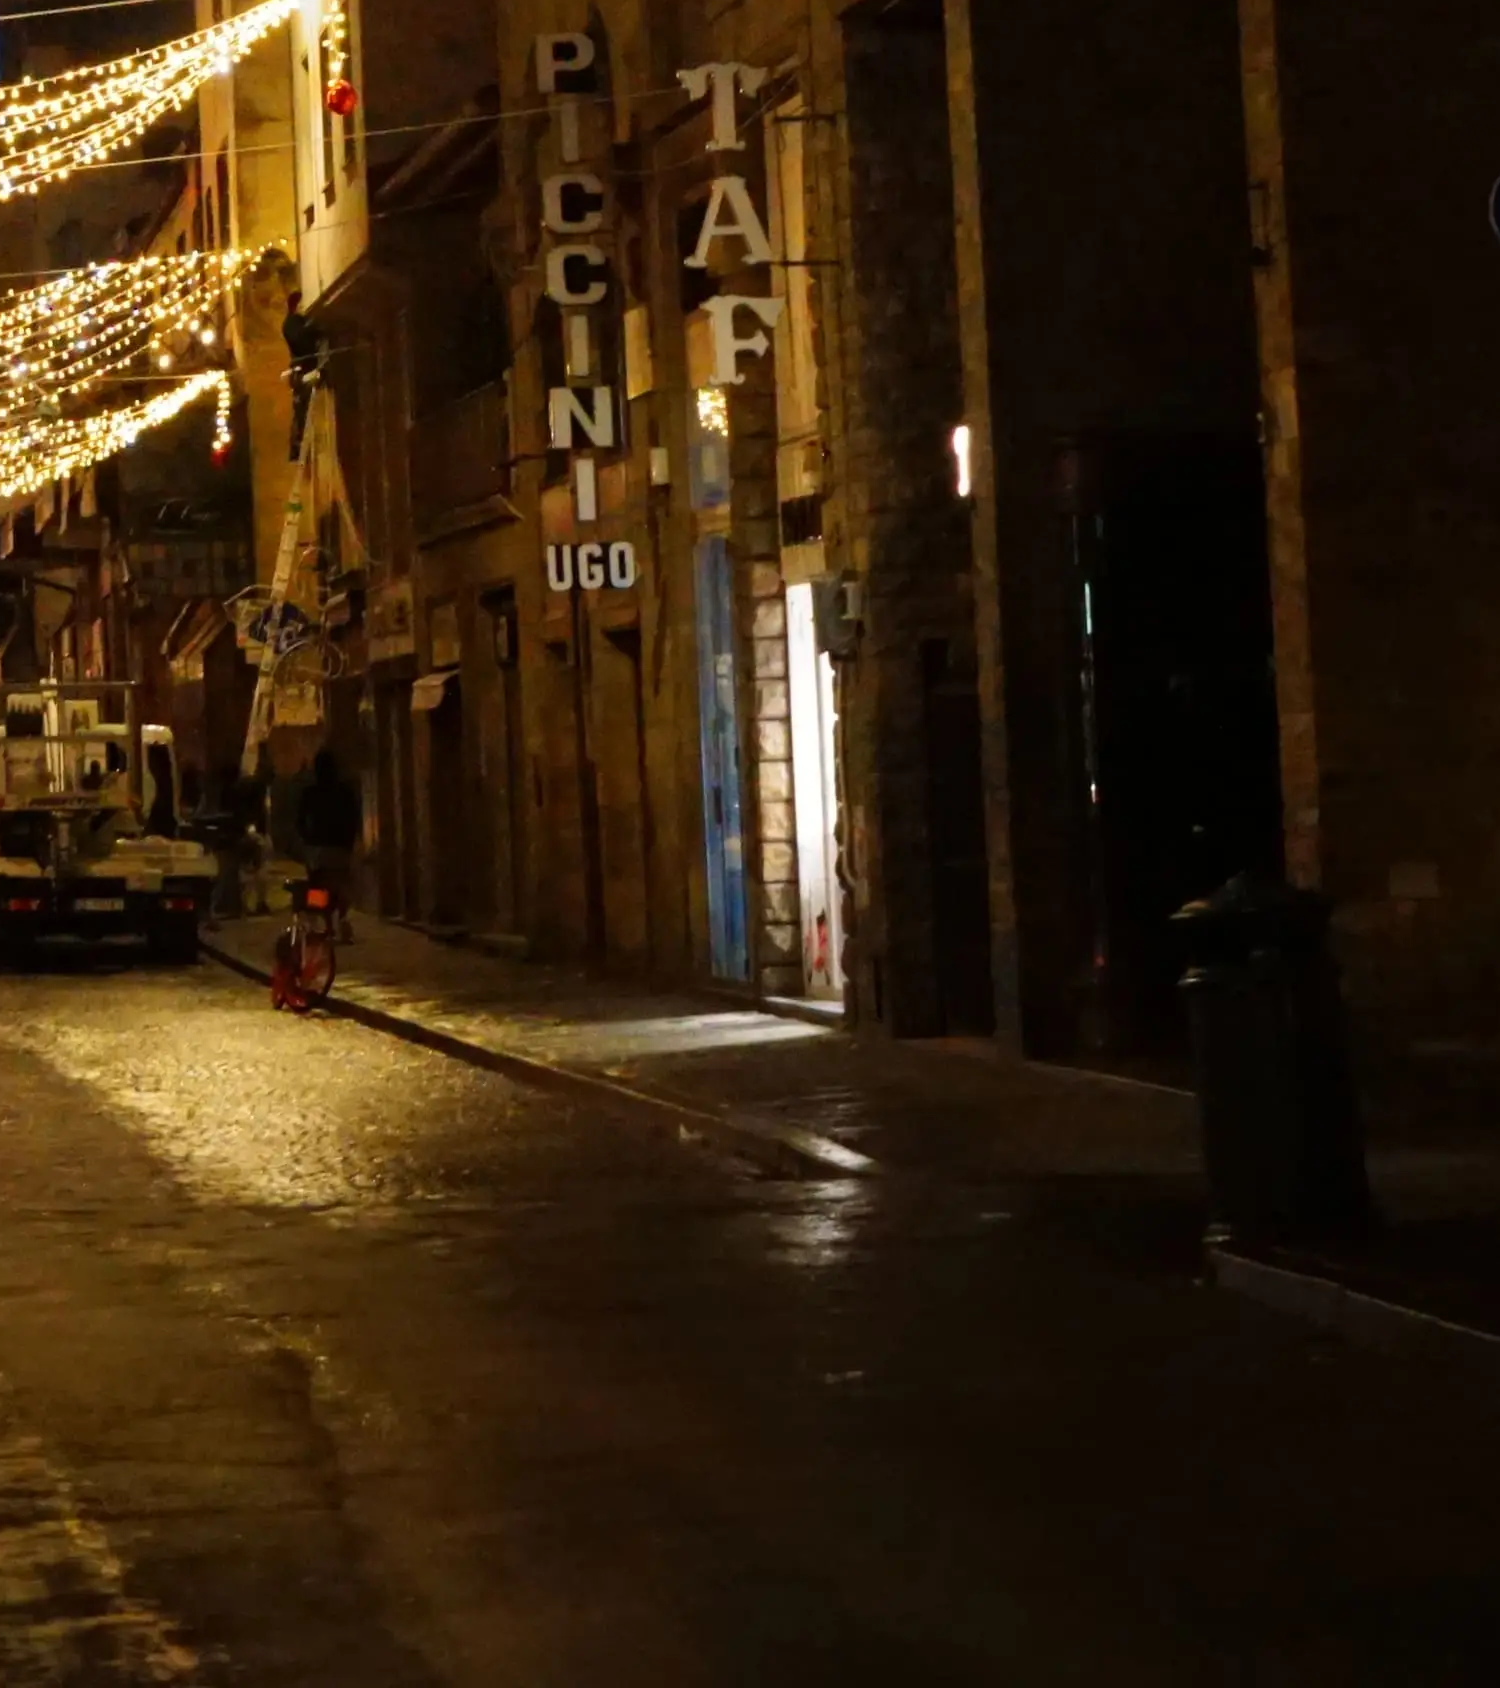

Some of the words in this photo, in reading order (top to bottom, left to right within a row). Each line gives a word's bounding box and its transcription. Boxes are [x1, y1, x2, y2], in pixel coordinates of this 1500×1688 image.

[535, 32, 616, 522] PICCINI
[675, 61, 788, 388] TAF
[546, 540, 638, 593] UGO
